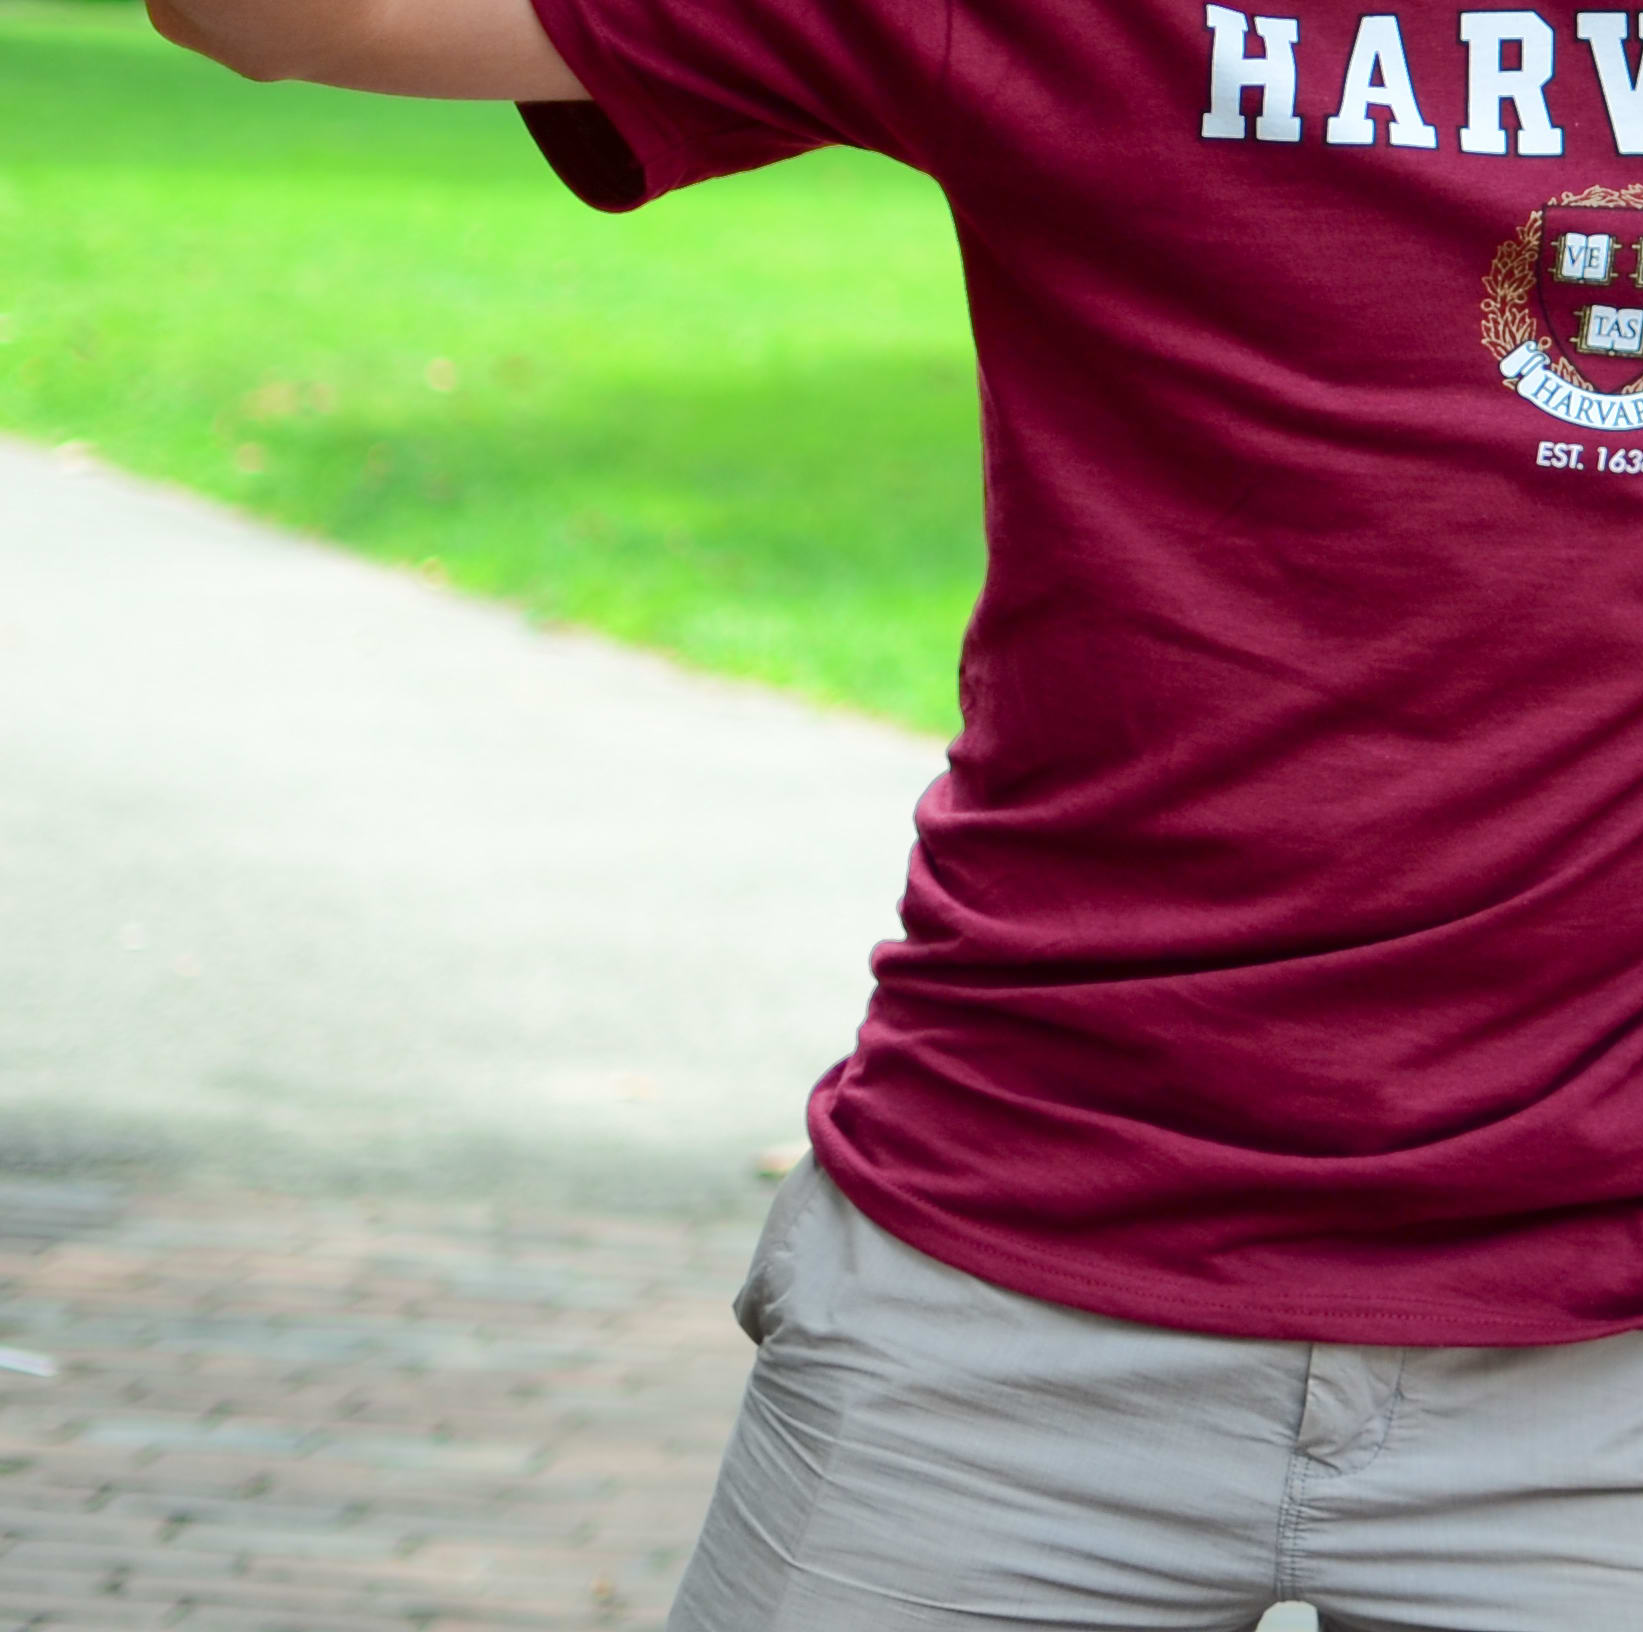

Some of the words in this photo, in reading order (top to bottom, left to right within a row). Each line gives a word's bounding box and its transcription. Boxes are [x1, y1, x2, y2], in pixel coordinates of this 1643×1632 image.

[1567, 244, 1601, 269] VE
[1593, 315, 1639, 341] TAS
[1535, 440, 1584, 471] EST.
